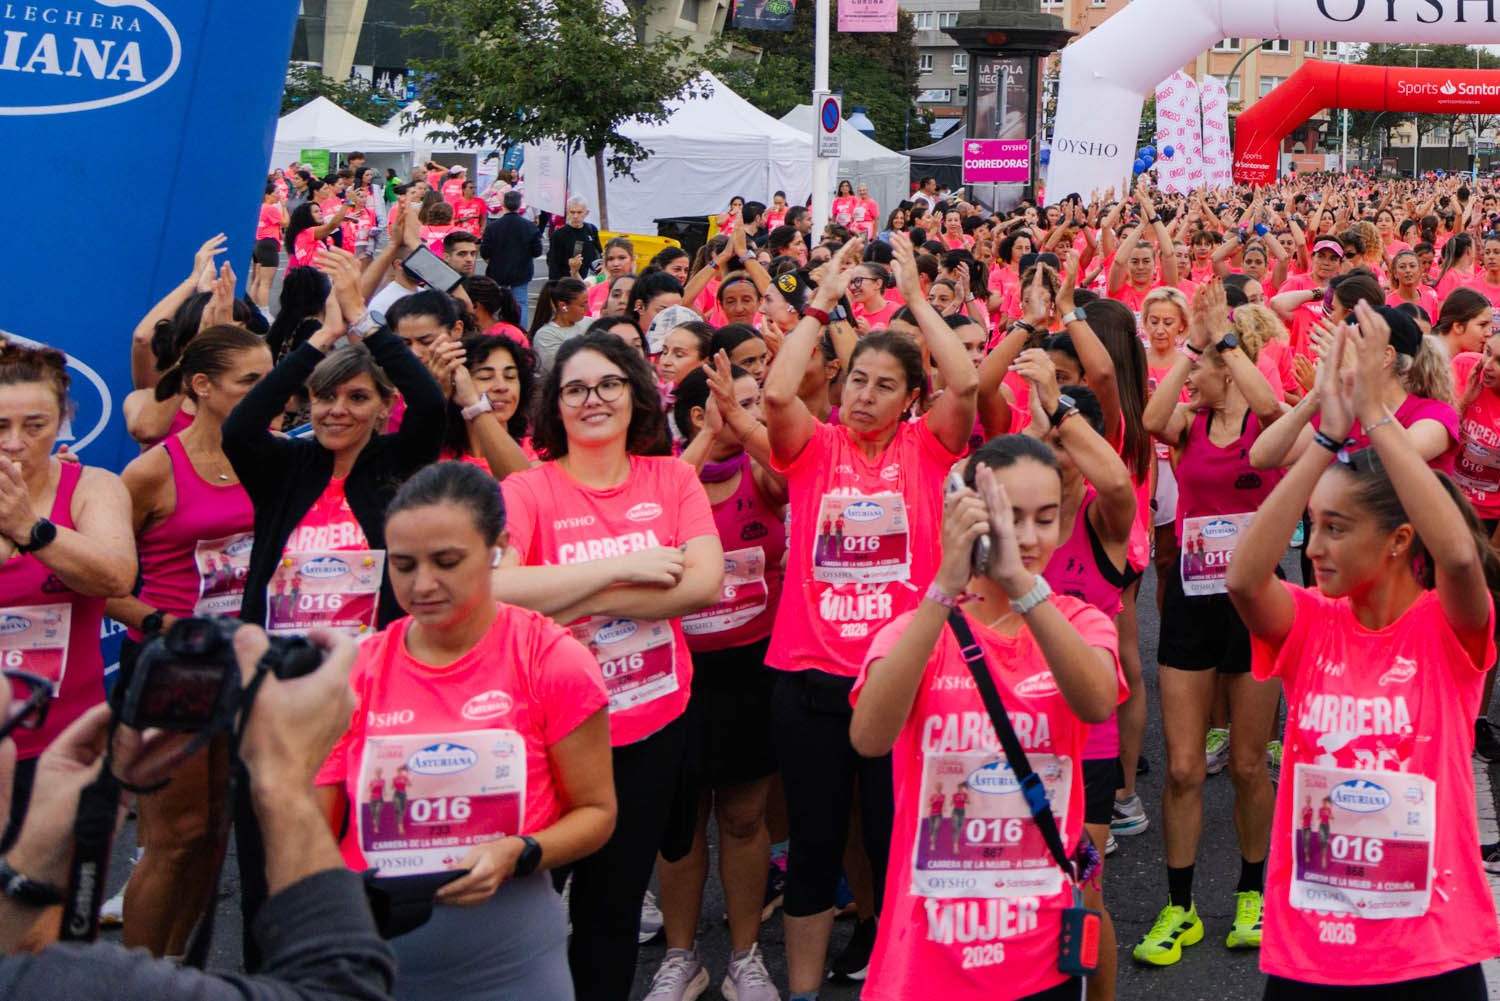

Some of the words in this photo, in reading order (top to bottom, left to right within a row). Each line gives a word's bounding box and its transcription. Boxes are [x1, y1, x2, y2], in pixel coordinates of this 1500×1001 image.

[5, 4, 142, 32] LECHERA
[979, 64, 990, 74] LA
[1397, 80, 1439, 96] Sports
[1057, 138, 1118, 158] OYSHO
[965, 159, 1028, 169] CORREDORAS
[1462, 458, 1484, 473] 016
[847, 509, 882, 518] ASTURIANA
[558, 529, 662, 565] CARRERA
[843, 536, 881, 551] 016
[299, 594, 342, 610] 016
[820, 590, 893, 621] MUJER
[840, 623, 868, 638] 2026
[602, 652, 644, 678] 016
[413, 757, 473, 769] ASTURIANA
[1334, 791, 1387, 806] ASTURIANA
[410, 797, 472, 822] 016
[966, 818, 1023, 843] 016
[1331, 835, 1384, 862] 016
[375, 857, 424, 868] OYSHO
[927, 860, 961, 869] CARRERA
[962, 860, 974, 869] DE
[974, 860, 985, 869] LA
[986, 859, 1012, 868] MUJER
[928, 877, 977, 890] OYSHO
[1384, 879, 1416, 890] CORUÑA
[1366, 898, 1412, 910] Santander
[926, 898, 1040, 945] MUJER
[1319, 921, 1356, 945] 2026
[962, 943, 1005, 970] 2026
